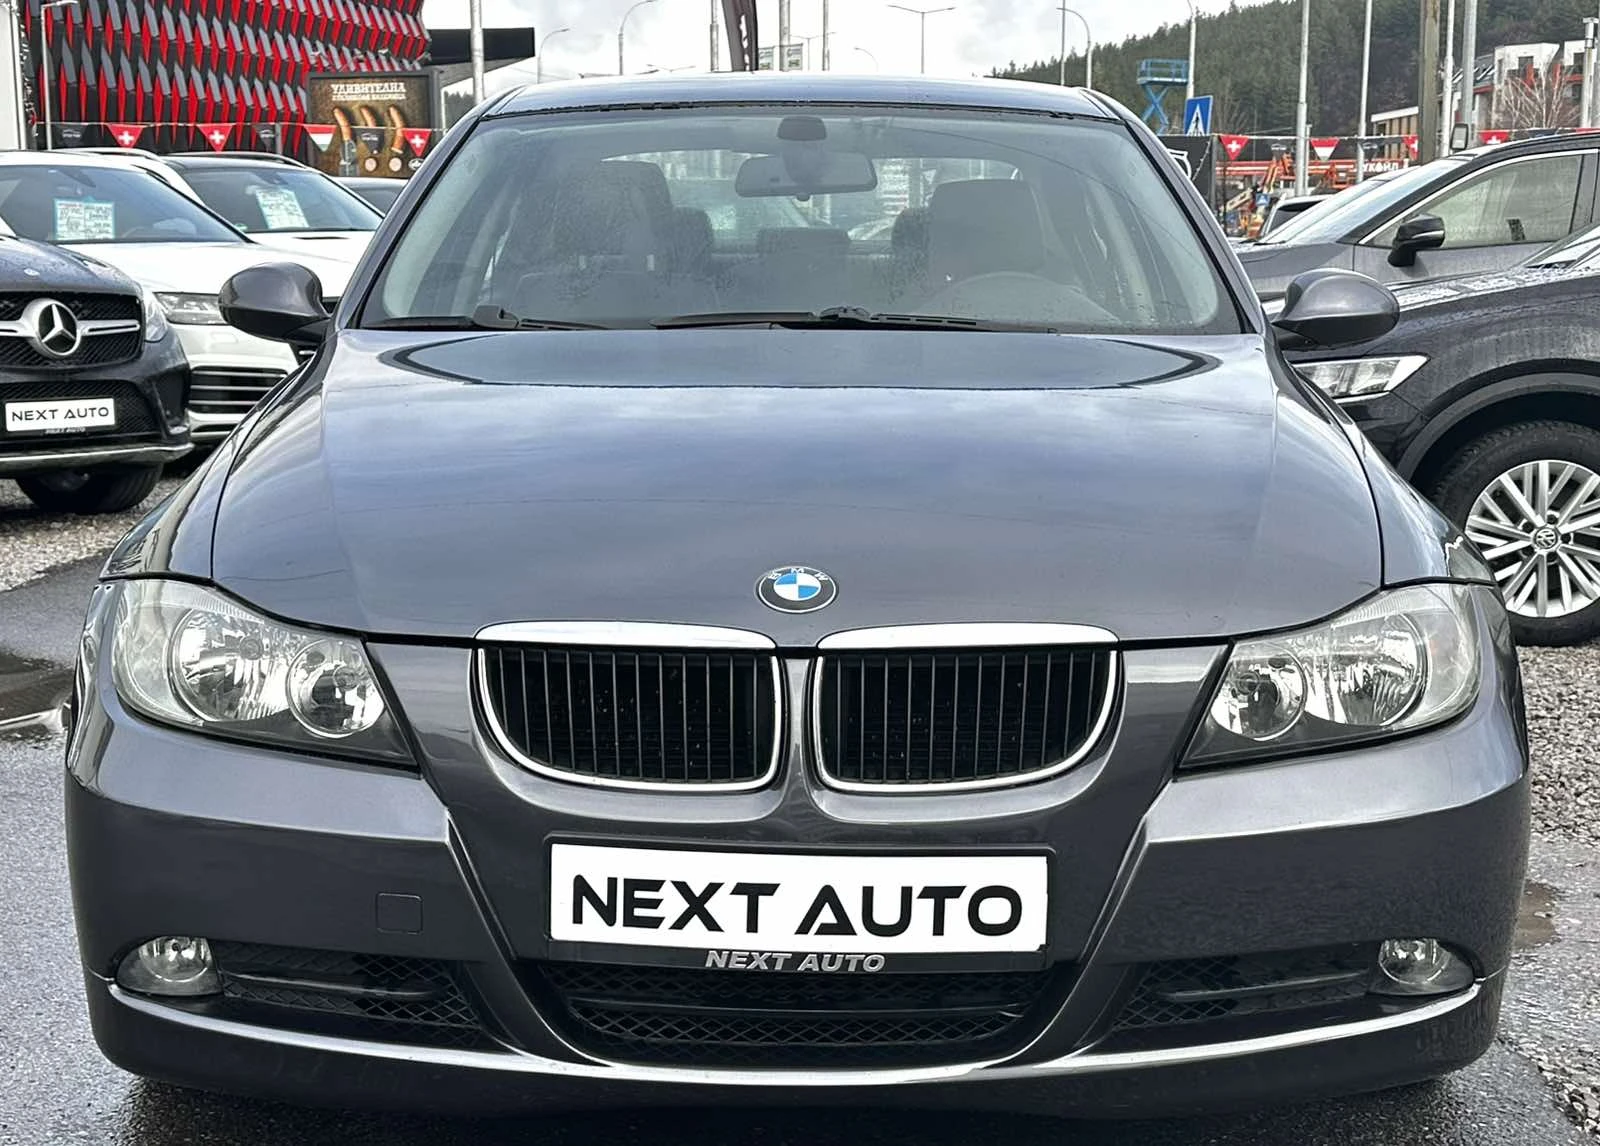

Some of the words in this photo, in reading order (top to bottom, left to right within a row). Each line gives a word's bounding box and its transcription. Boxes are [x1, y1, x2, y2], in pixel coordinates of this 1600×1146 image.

[12, 409, 58, 422] NEXT
[64, 407, 109, 419] AUTO
[767, 567, 829, 580] BMW
[572, 874, 781, 933] NEXT
[794, 884, 1022, 937] AUTO
[705, 950, 793, 970] NEXT
[797, 953, 886, 972] AUTO
